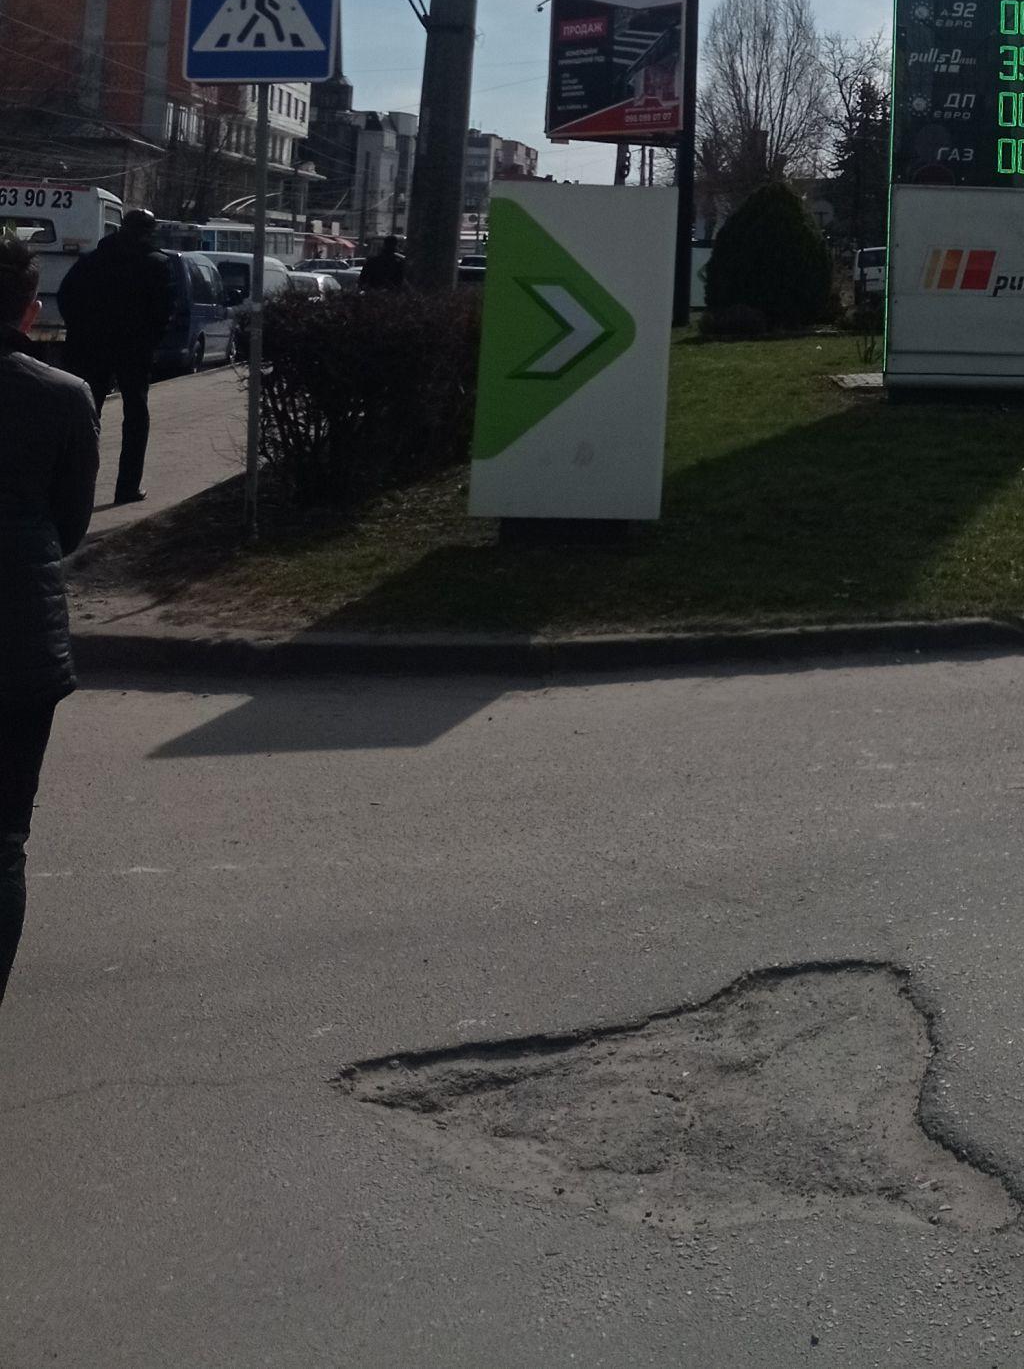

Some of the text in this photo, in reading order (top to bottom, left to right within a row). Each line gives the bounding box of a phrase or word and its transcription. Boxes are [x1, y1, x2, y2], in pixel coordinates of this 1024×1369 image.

[563, 22, 604, 36] ПРОДАЖ
[944, 93, 976, 108] ДП
[936, 146, 975, 161] ГАЗ
[24, 189, 46, 207] 90
[51, 190, 73, 208] 23
